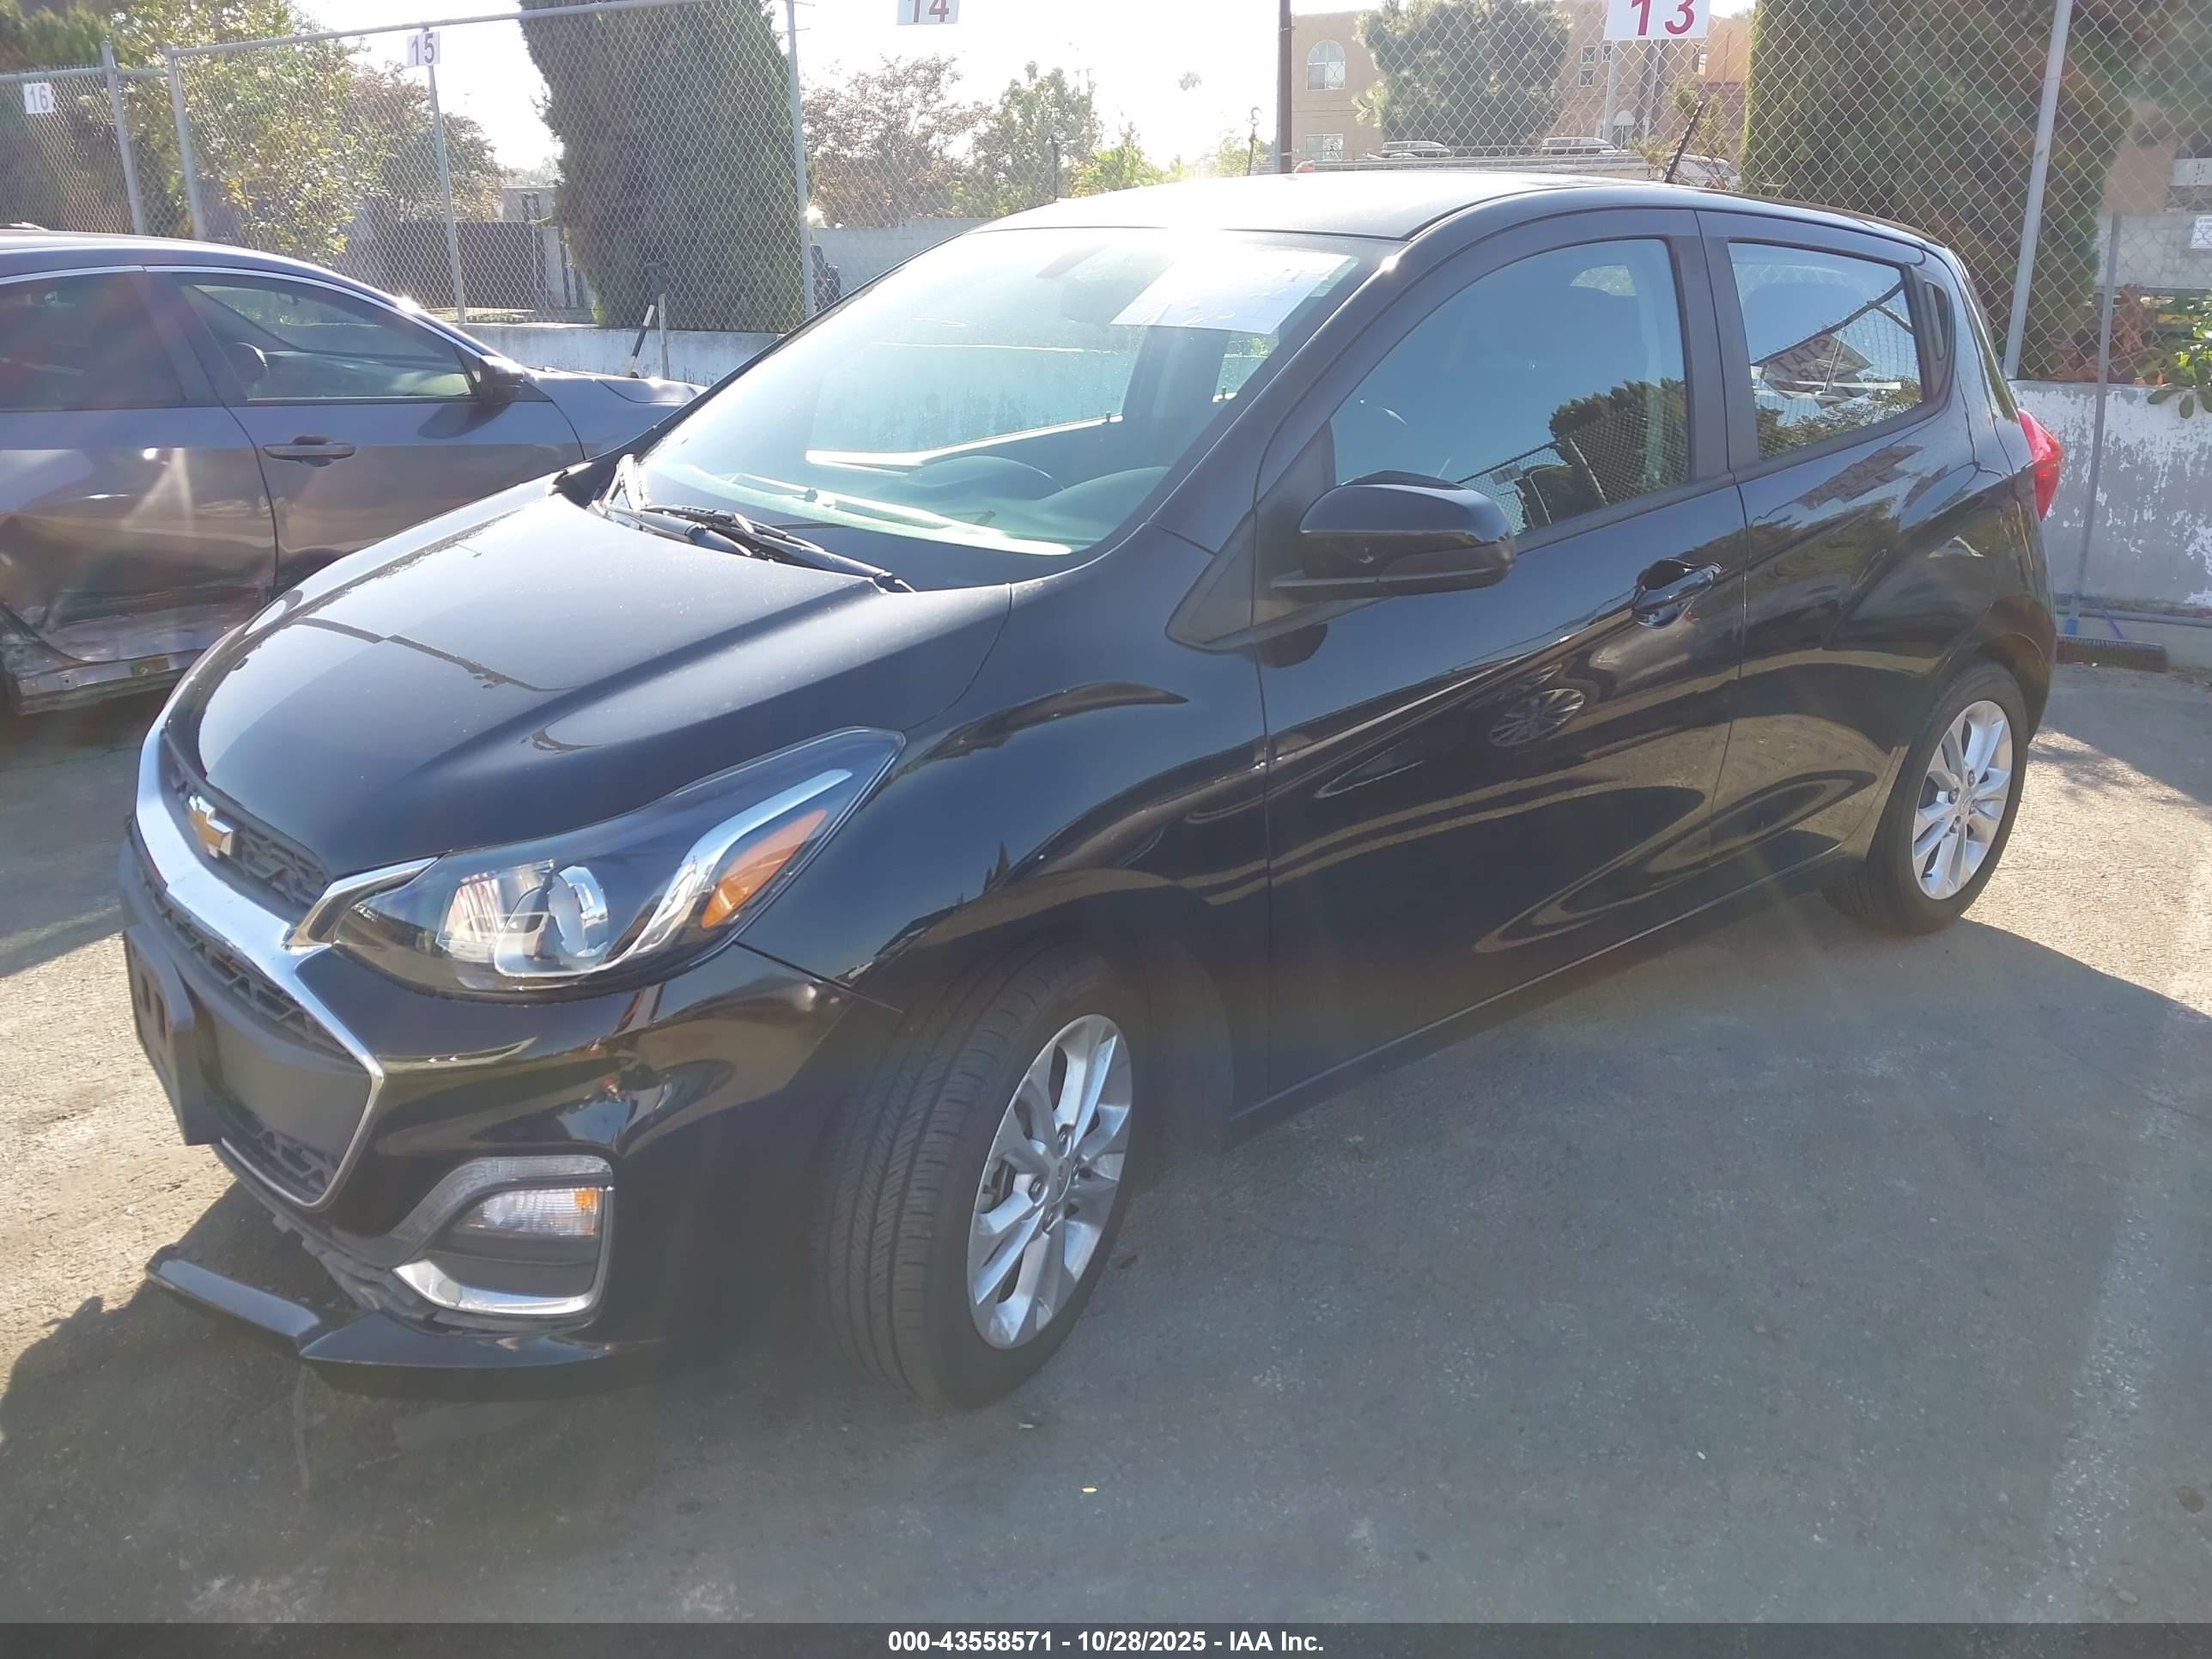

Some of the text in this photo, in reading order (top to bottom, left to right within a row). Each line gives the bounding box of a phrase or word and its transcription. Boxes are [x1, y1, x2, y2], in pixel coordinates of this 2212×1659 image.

[907, 0, 949, 22] 14
[1632, 0, 1695, 36] 13
[411, 33, 434, 66] 15
[29, 85, 49, 112] 16
